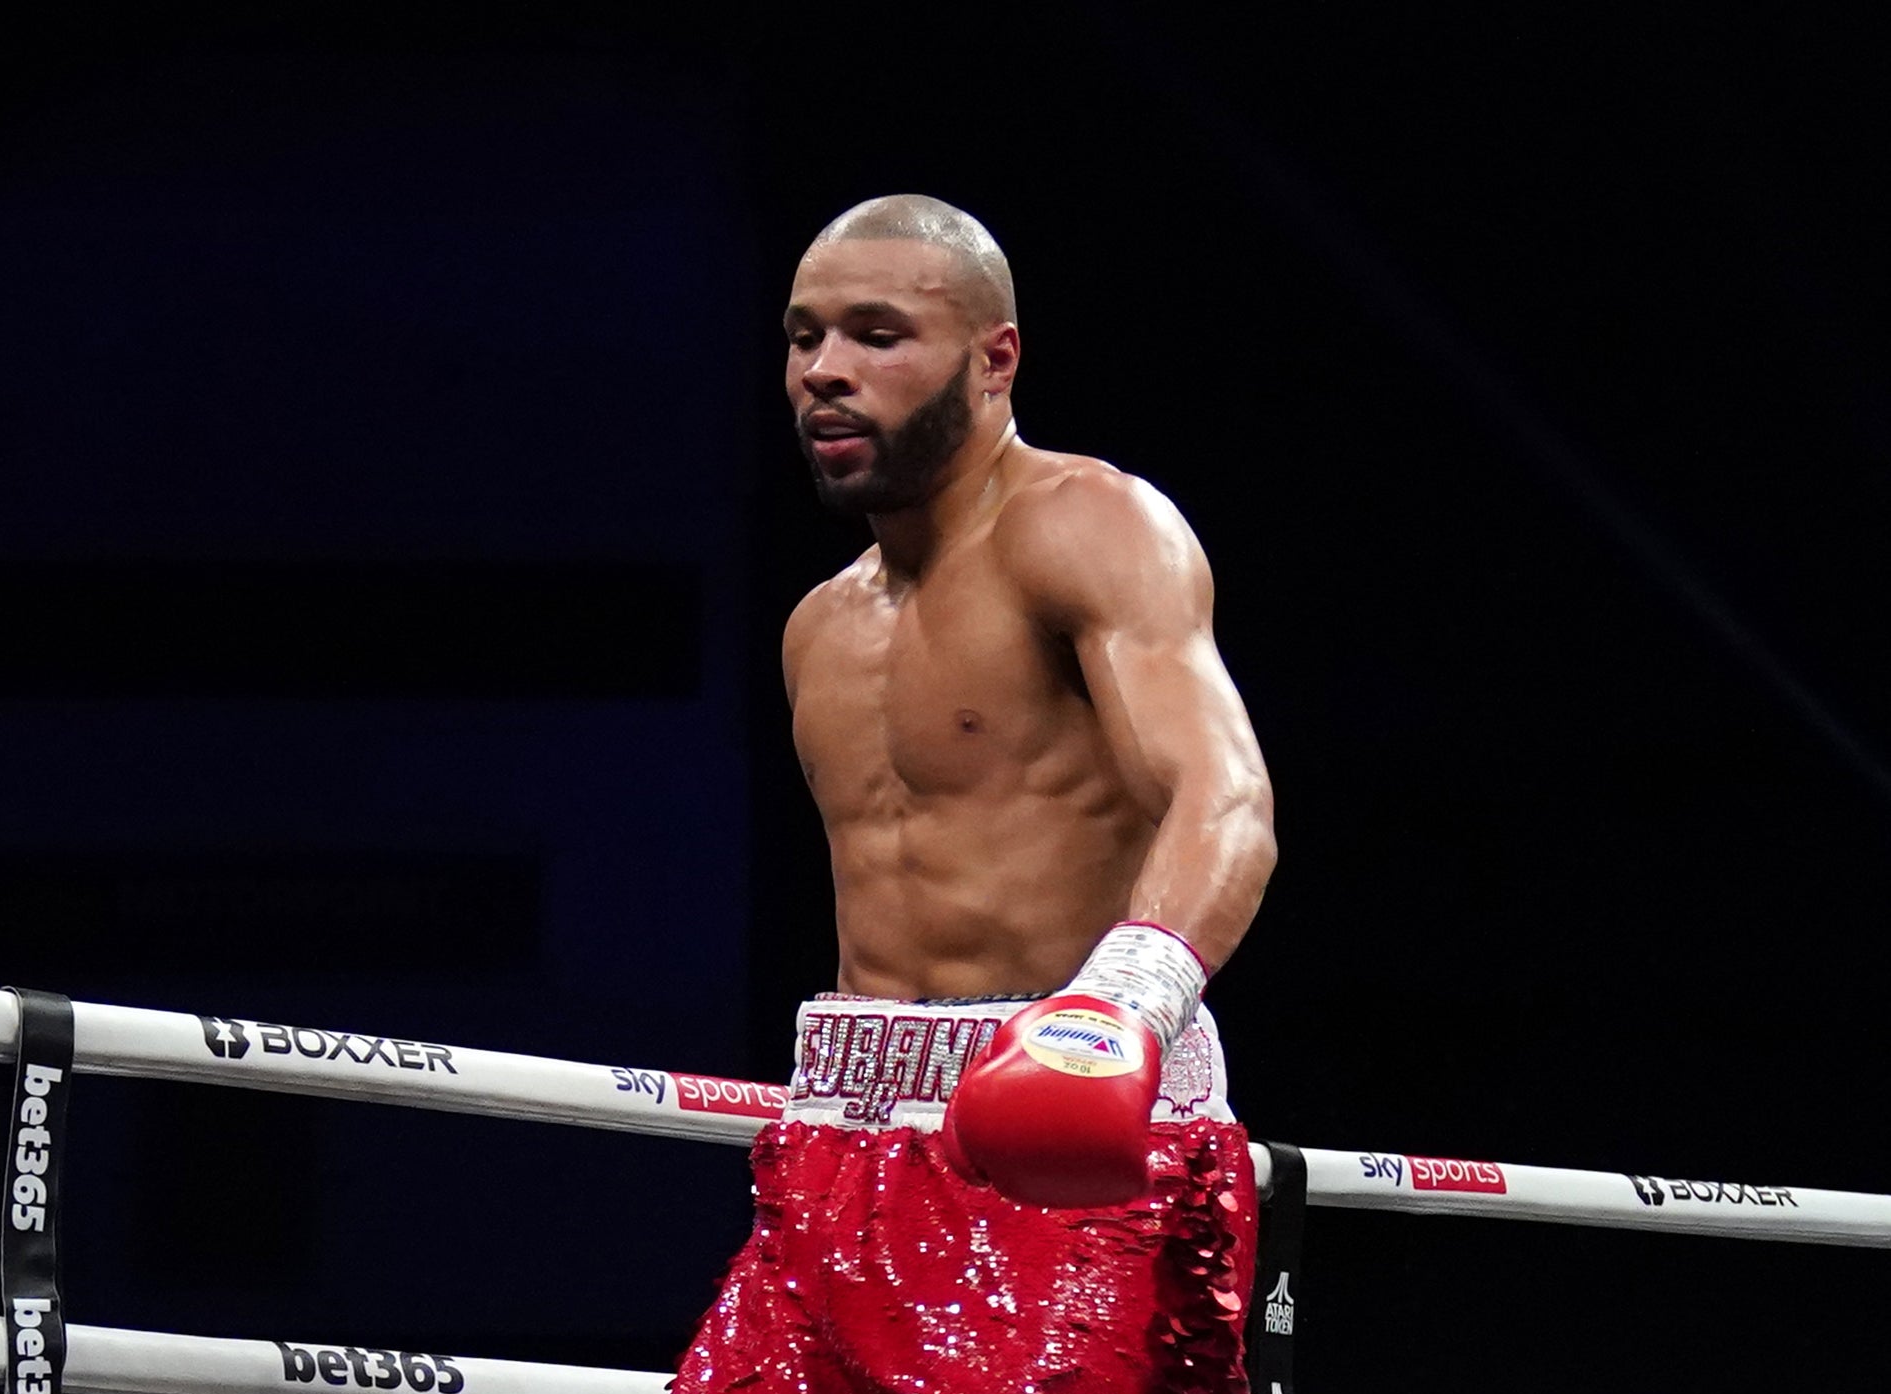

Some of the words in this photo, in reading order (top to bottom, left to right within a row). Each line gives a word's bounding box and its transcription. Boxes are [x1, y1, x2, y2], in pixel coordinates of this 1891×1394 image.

[256, 1022, 459, 1075] BOXXER
[613, 1066, 667, 1105] sky
[678, 1076, 788, 1110] sports
[11, 1063, 63, 1232] bet365
[1359, 1153, 1404, 1187] sky
[1415, 1158, 1501, 1188] sports
[1667, 1179, 1800, 1208] BOXXER
[1264, 1302, 1294, 1319] ATARI
[1264, 1317, 1293, 1335] TOKEN
[275, 1341, 466, 1394] bet365
